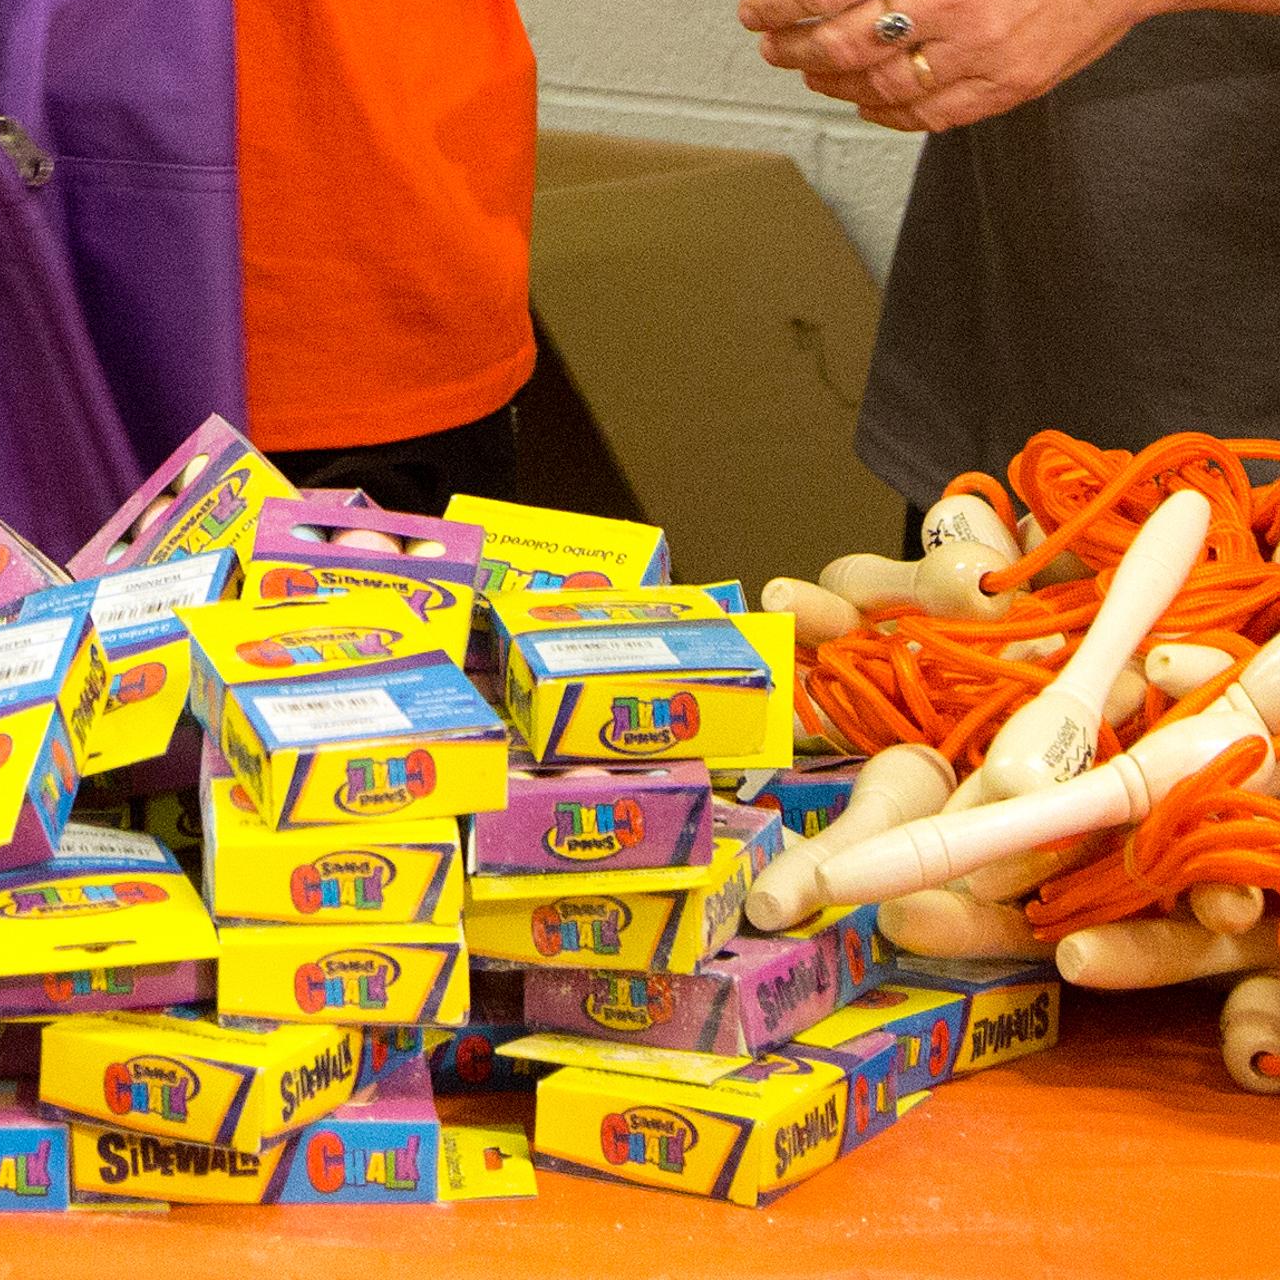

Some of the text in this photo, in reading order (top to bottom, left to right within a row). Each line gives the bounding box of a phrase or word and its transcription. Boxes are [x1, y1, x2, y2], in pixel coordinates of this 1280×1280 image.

[500, 531, 559, 554] Colored
[562, 545, 615, 563] Jumbo
[305, 1130, 421, 1195] CHALK
